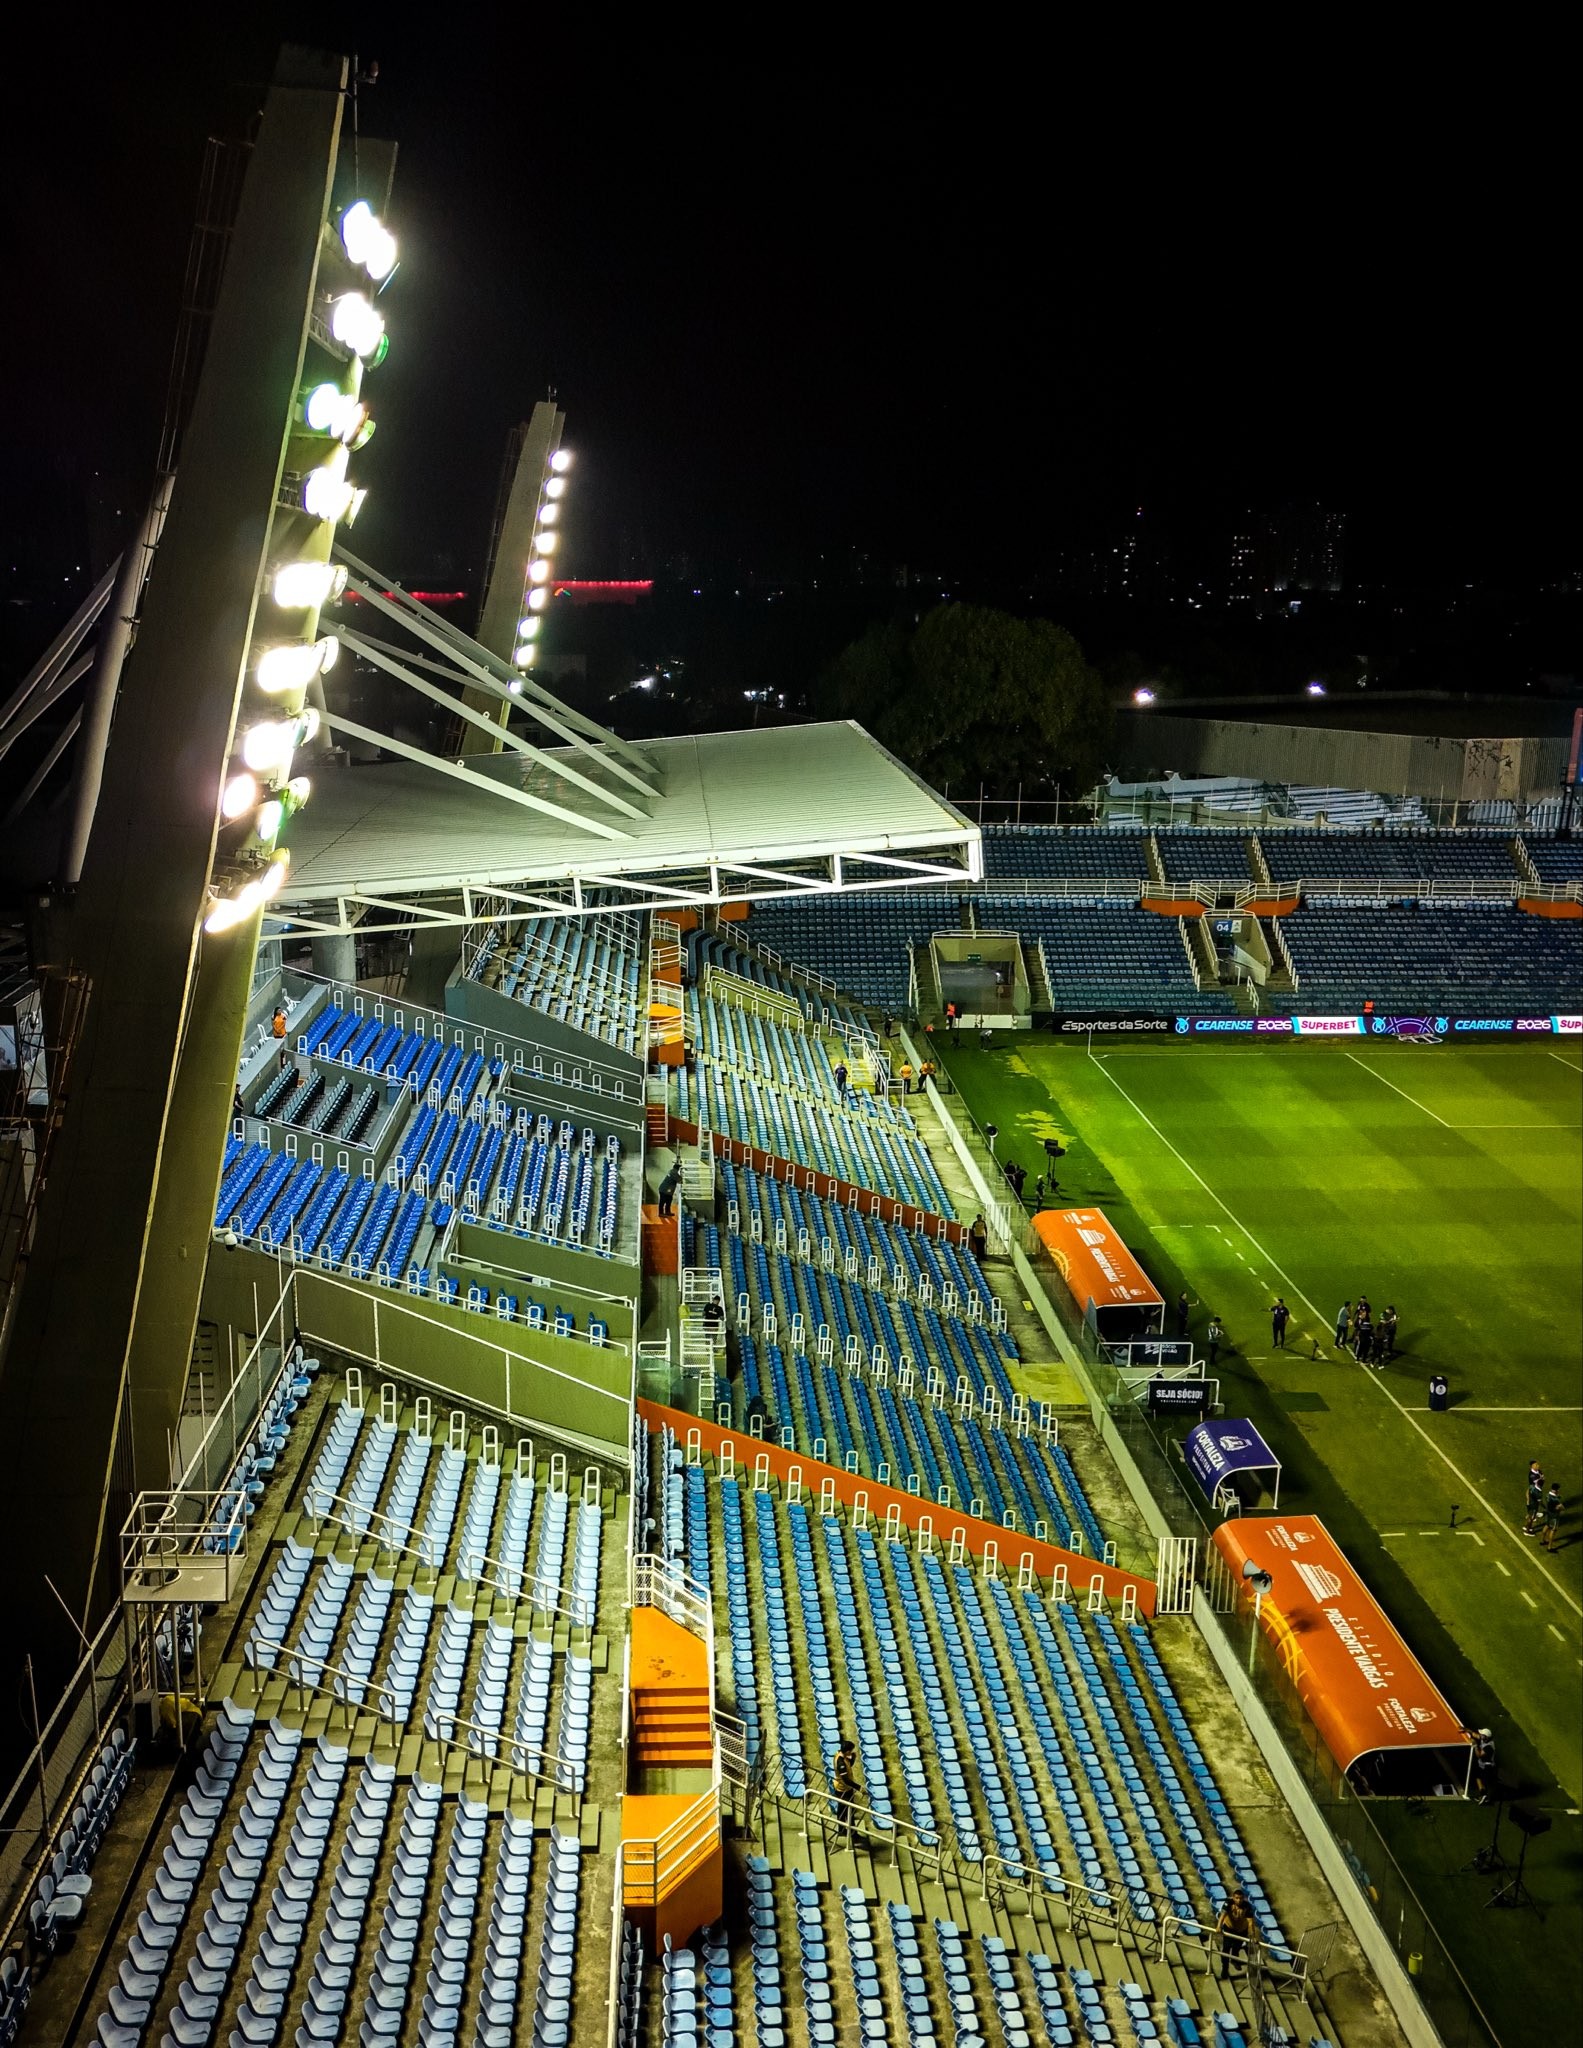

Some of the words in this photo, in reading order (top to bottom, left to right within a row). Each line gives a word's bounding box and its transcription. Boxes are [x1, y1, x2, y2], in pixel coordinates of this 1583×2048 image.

[1216, 923, 1230, 932] 04
[1195, 1019, 1254, 1031] CEARENSE
[1257, 1020, 1292, 1031] 2026
[1300, 1019, 1357, 1030] SUPERBET
[1454, 1019, 1513, 1030] CEARENSE
[1516, 1019, 1551, 1030] 2026
[1156, 1389, 1176, 1398] SEJA
[1177, 1388, 1203, 1399] SÓCIO!
[1193, 1444, 1212, 1474] PREFEITURA
[1195, 1430, 1225, 1471] FORTALEZA
[1275, 1525, 1298, 1551] FORTALEZA
[1322, 1608, 1367, 1655] PRESIDENTE
[1353, 1654, 1388, 1689] VARGAS
[1387, 1698, 1417, 1734] FORTALEZA
